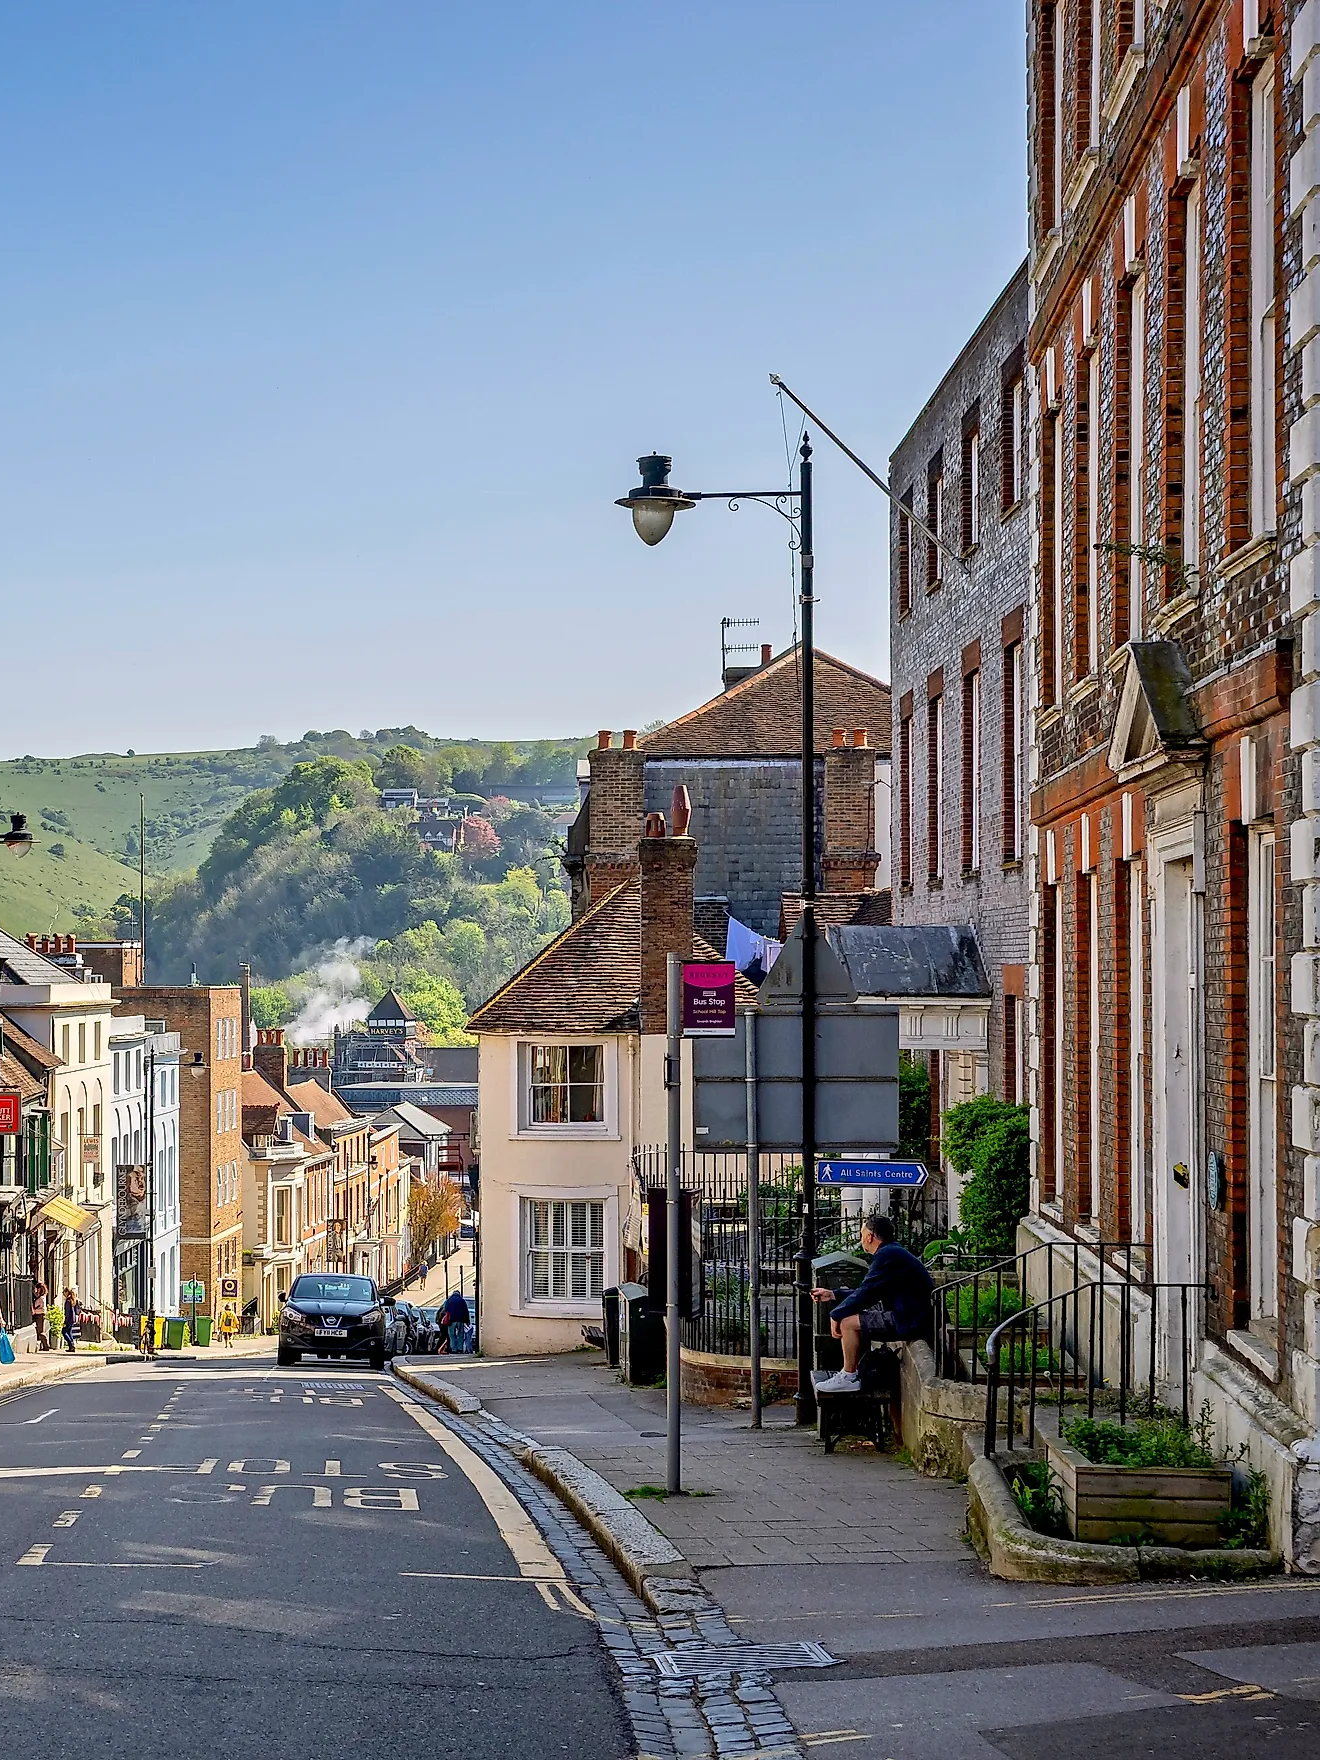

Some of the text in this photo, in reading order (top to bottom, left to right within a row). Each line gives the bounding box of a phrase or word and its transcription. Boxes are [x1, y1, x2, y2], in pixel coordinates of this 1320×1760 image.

[708, 998, 726, 1007] Stop
[840, 1168, 913, 1179] All Saints Centre
[117, 1168, 128, 1236] GLYNDEBOURNE
[154, 1458, 448, 1480] STOP
[164, 1483, 420, 1511] BUS
